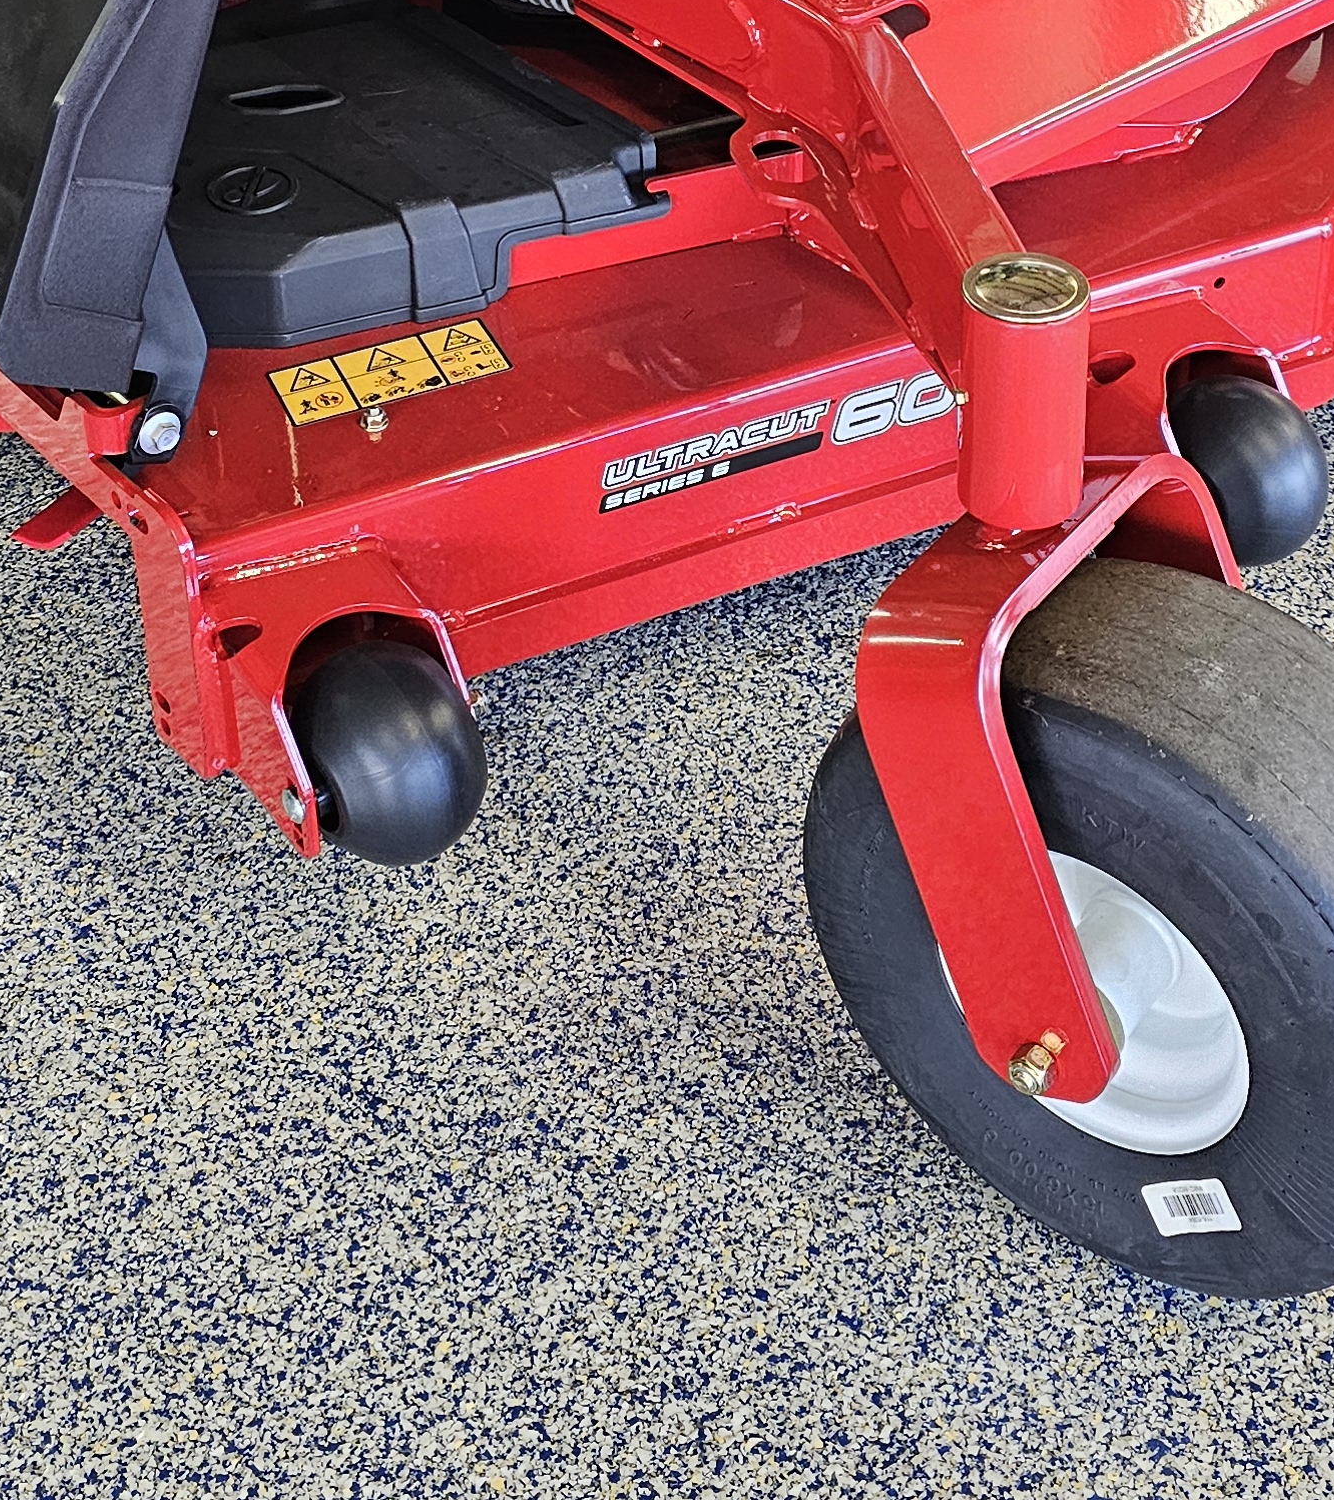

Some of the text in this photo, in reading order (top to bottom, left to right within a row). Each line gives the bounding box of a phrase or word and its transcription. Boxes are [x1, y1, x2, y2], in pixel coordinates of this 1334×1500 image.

[600, 399, 832, 490] ULTRACUT
[604, 460, 731, 510] SERIES 6
